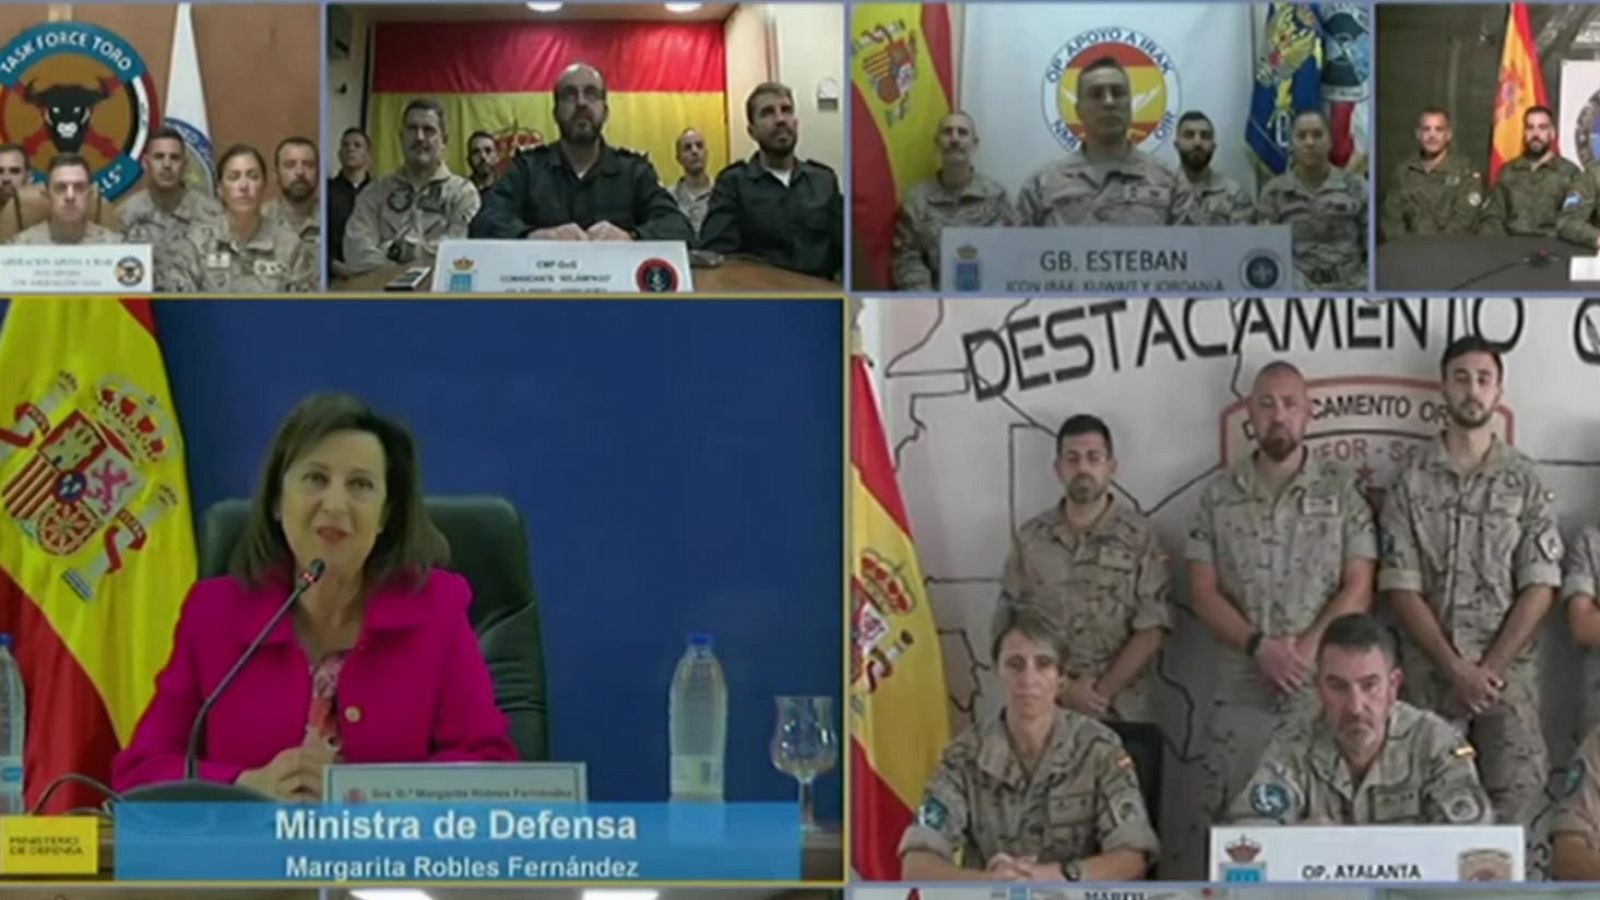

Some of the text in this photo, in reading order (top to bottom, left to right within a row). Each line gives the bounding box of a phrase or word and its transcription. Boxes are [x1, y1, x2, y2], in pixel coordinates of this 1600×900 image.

[0, 32, 131, 73] TASK FORCE TORO
[1067, 29, 1121, 56] APOYO
[1140, 37, 1173, 75] IRAK
[1039, 250, 1188, 272] GB. ESTEBAN
[961, 298, 1523, 401] DESTACAMENTO
[1301, 864, 1421, 879] OP. ATALANTA
